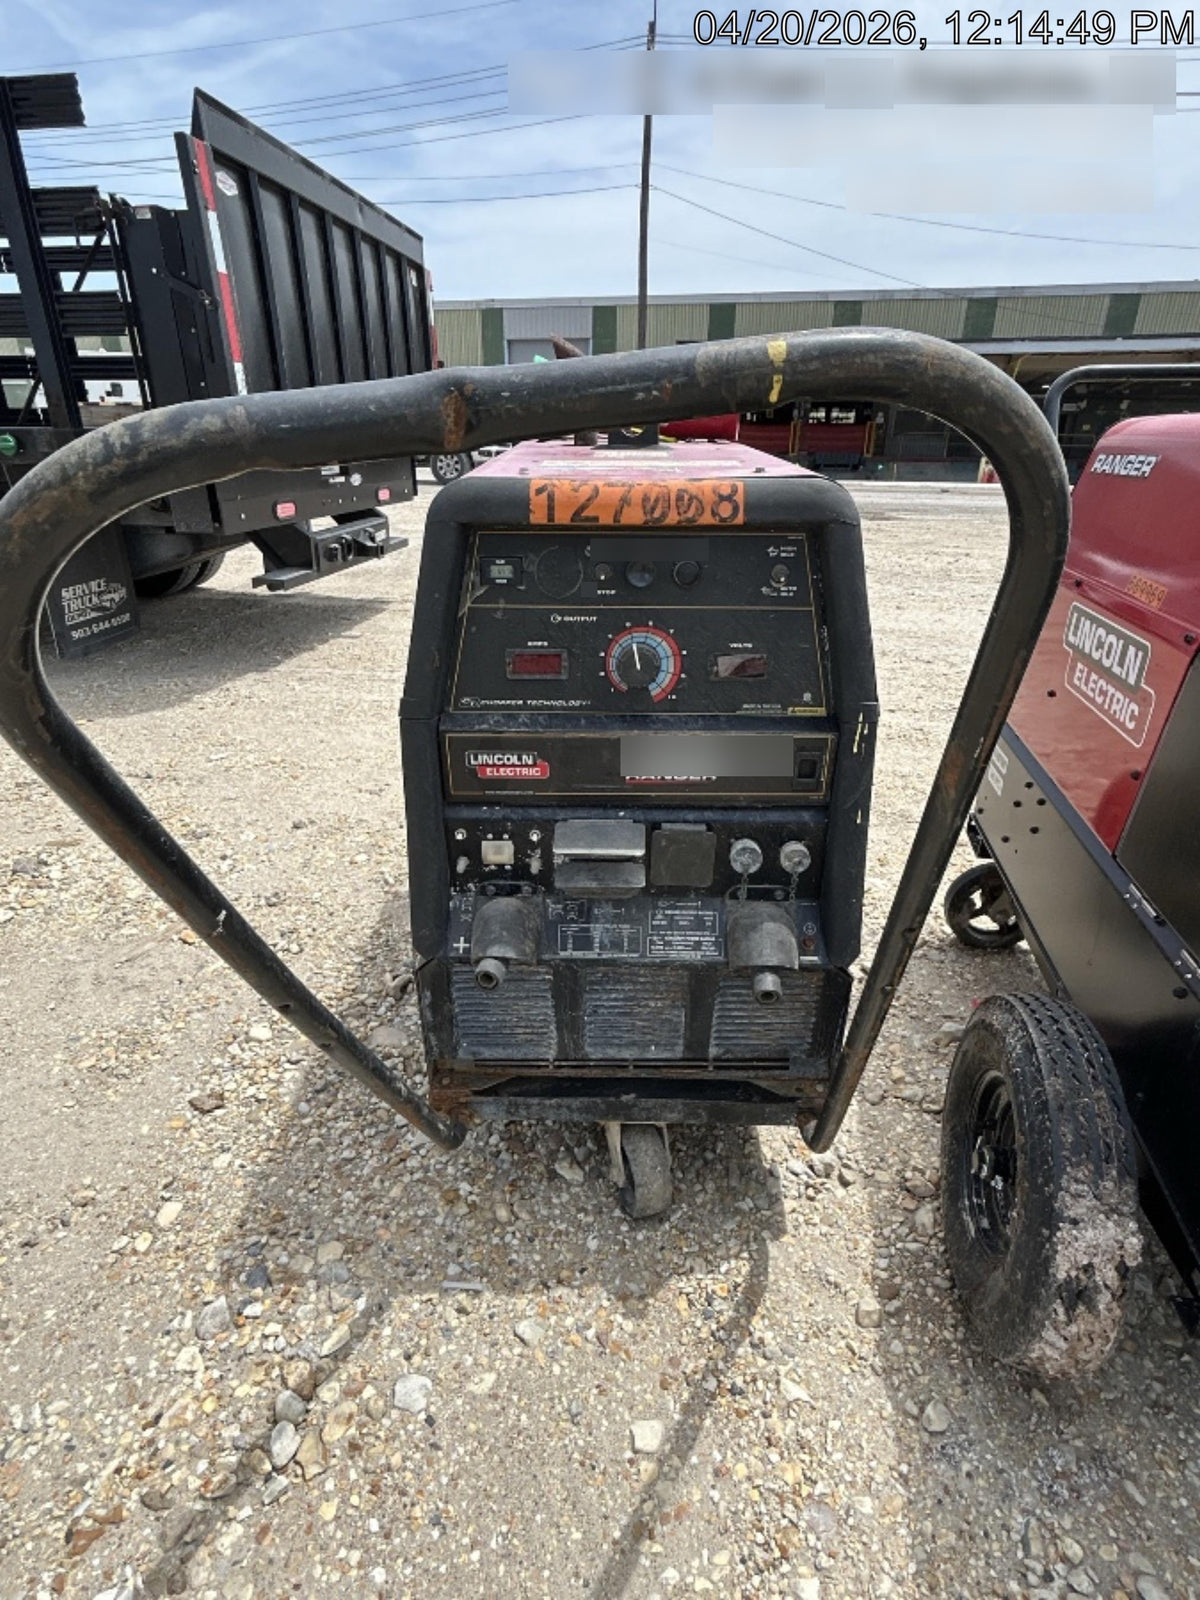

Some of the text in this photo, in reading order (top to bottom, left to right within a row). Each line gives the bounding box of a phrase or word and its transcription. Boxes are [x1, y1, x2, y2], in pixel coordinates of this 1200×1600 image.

[1091, 454, 1157, 477] RANGER
[535, 481, 740, 526] 127008
[62, 578, 107, 599] SERVICE
[62, 594, 100, 614] TRUCK
[563, 615, 598, 623] OUTPUT
[1067, 612, 1144, 687] LINCOLN
[1073, 661, 1140, 730] ELECTRIC
[470, 753, 533, 765] LINCOLN
[486, 767, 541, 776] ELECTRIC
